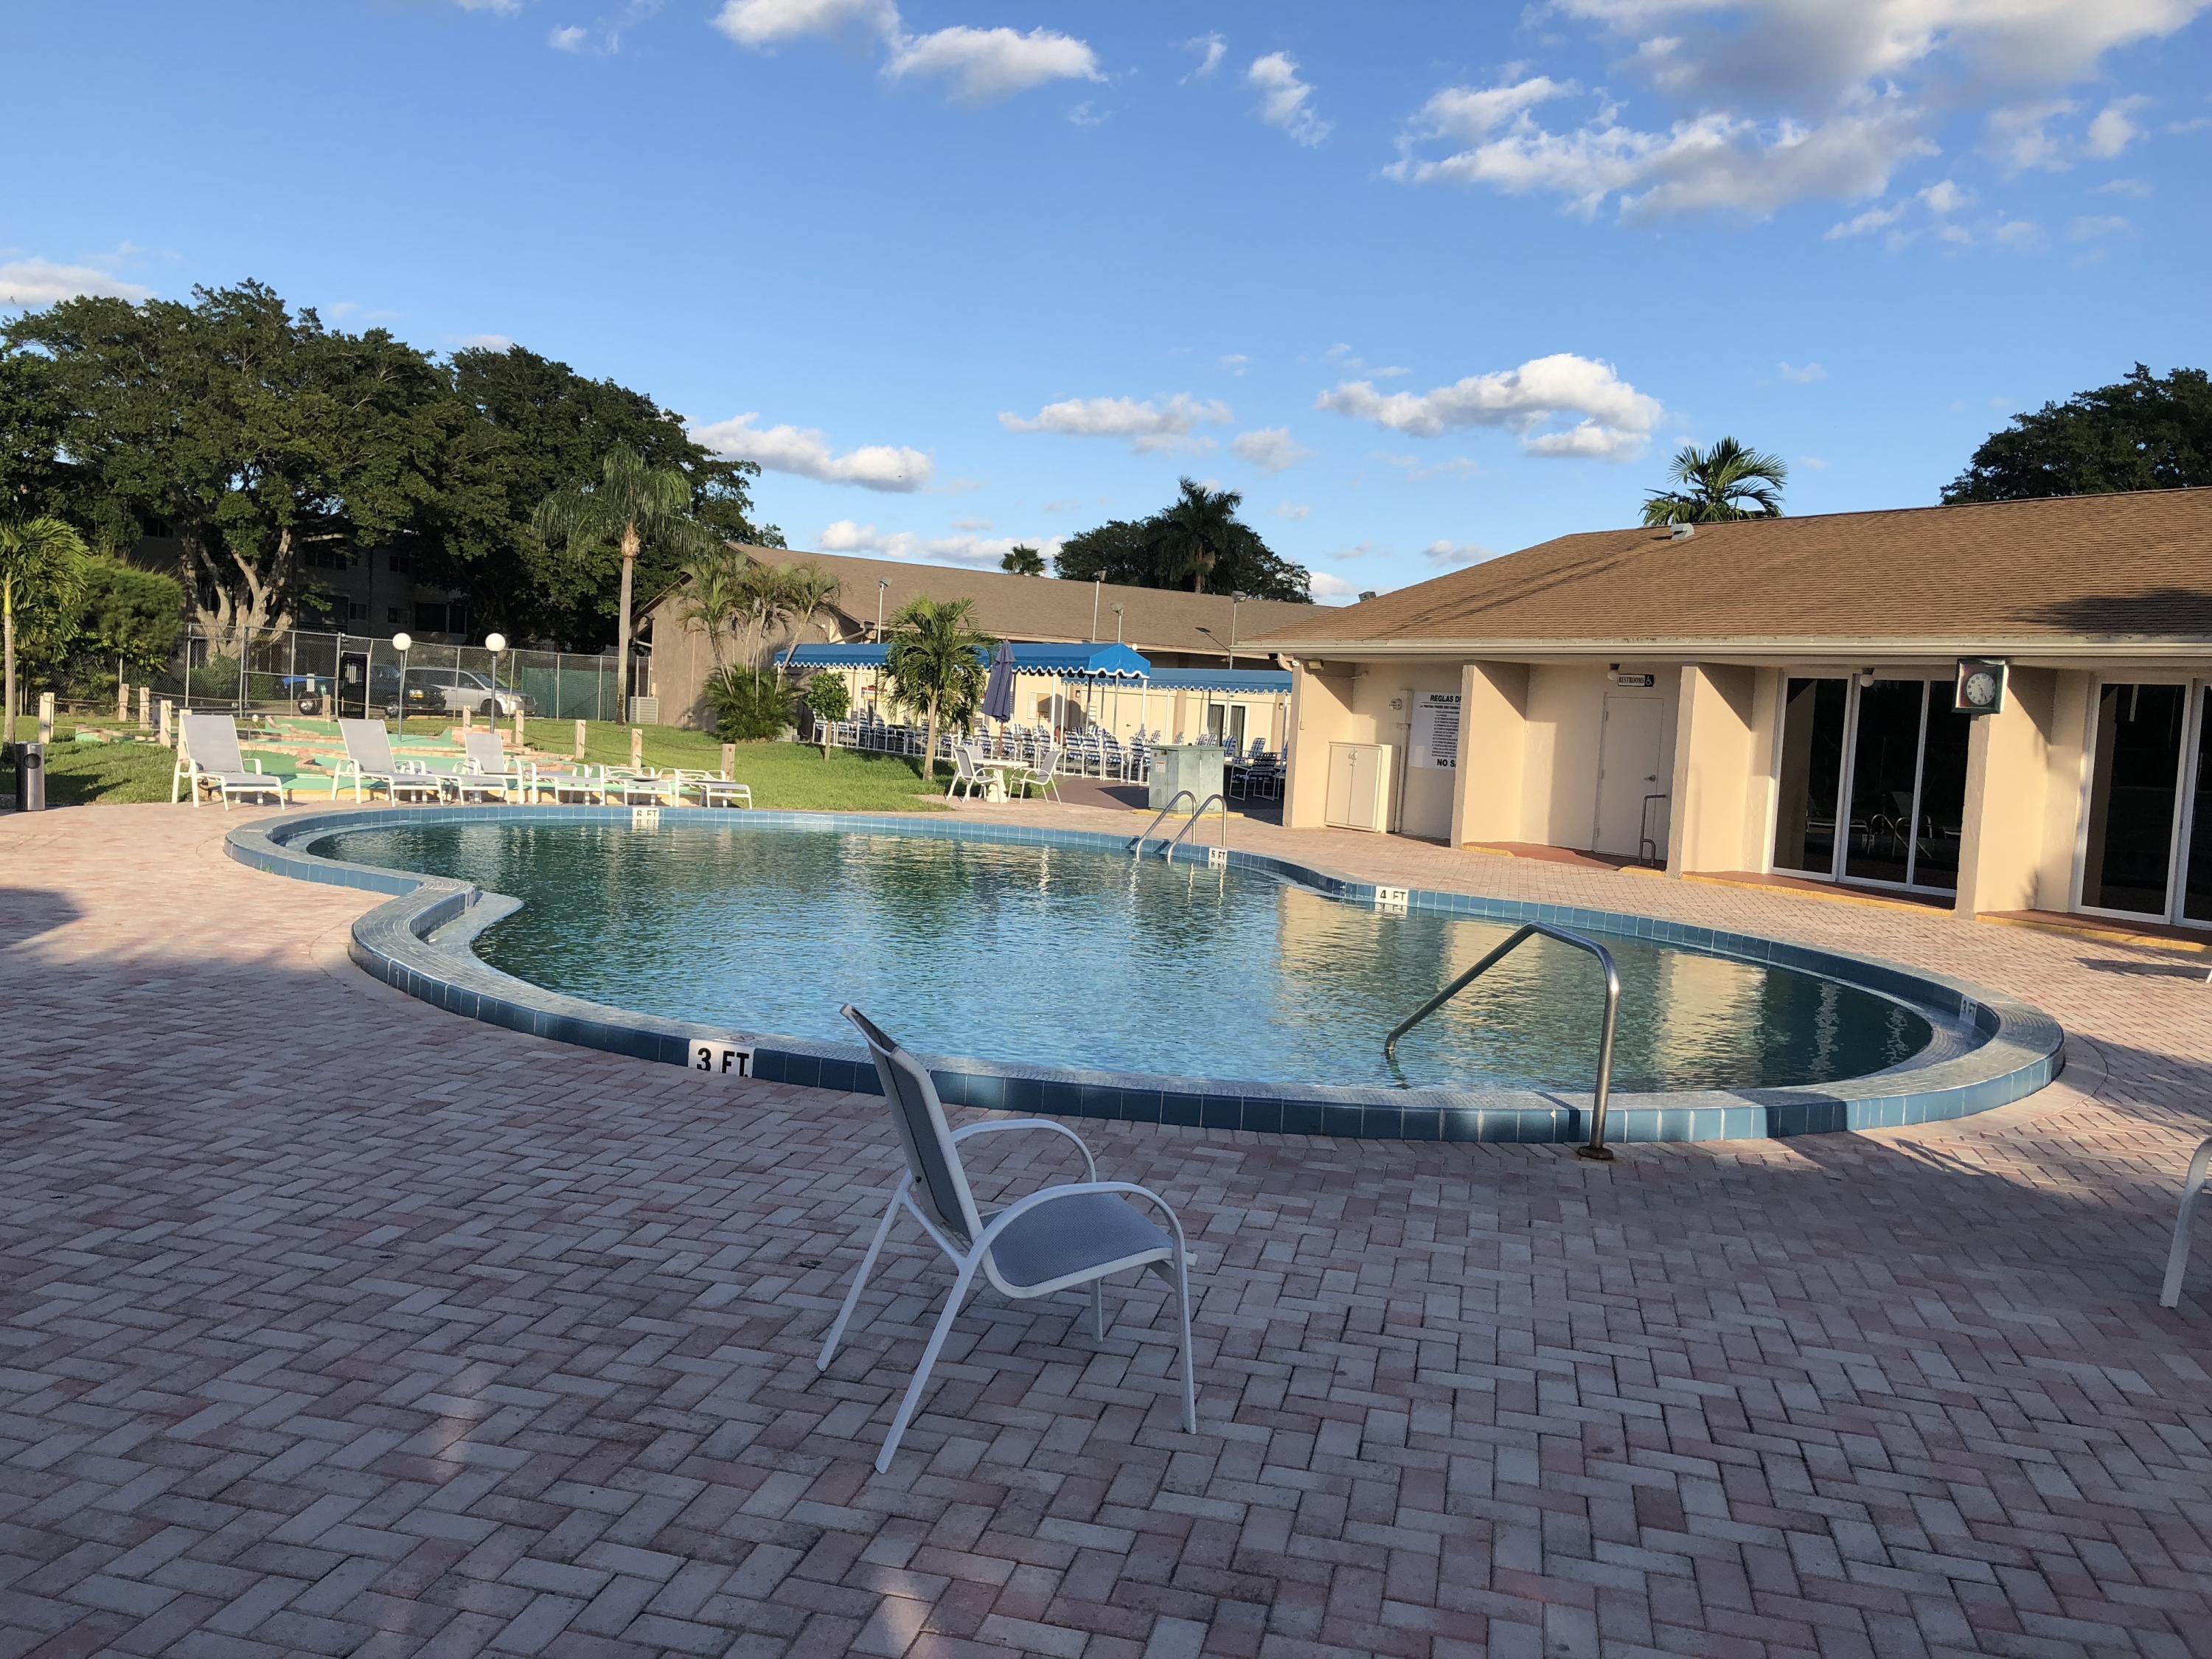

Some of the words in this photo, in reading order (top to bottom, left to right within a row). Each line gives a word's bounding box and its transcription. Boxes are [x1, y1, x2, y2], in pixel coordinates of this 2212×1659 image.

[1430, 695, 1454, 703] REGLAS
[1436, 758, 1448, 767] NO
[1450, 759, 1456, 768] S
[1211, 850, 1216, 858] 5
[1218, 851, 1226, 860] FT
[1380, 889, 1386, 899] 4
[1393, 890, 1406, 901] FT
[1961, 1000, 1966, 1014] 3
[1969, 1002, 1977, 1020] FT
[696, 1047, 712, 1071] 3
